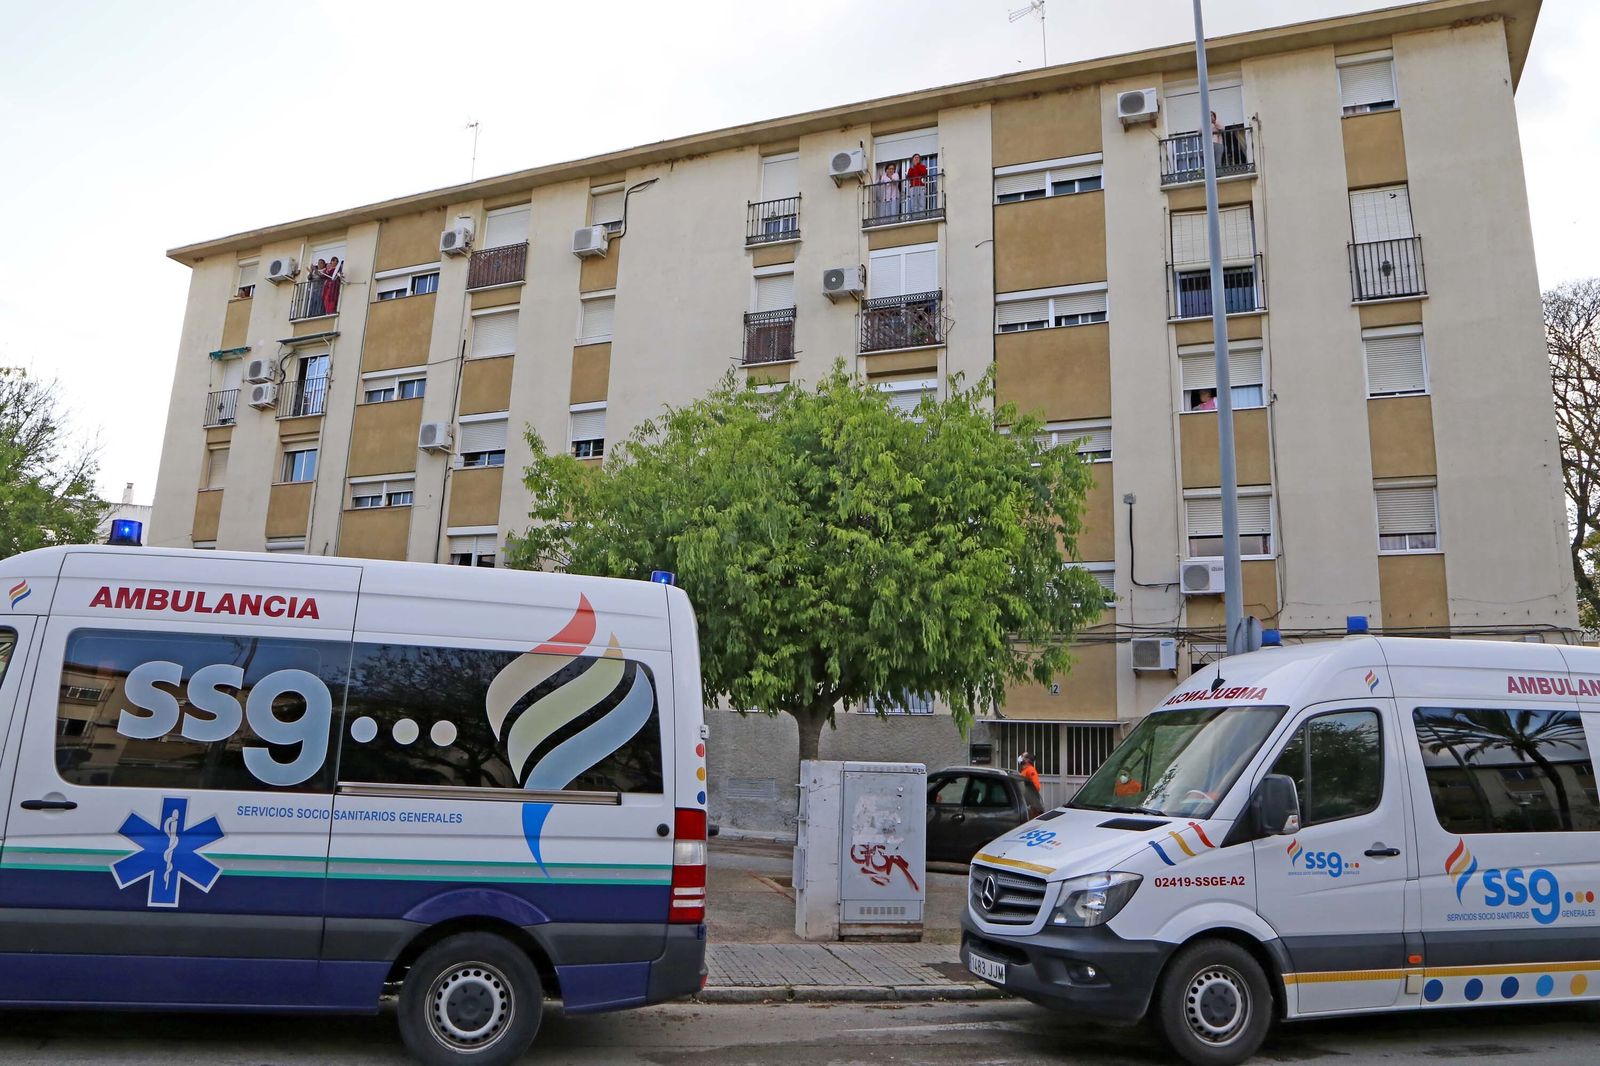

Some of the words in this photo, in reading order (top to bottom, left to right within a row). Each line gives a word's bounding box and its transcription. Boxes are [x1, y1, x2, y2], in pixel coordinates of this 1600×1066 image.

[89, 586, 320, 620] AMBULANCIA
[236, 805, 294, 818] SERVICIOS
[296, 808, 331, 820] SOCIO
[333, 809, 397, 822] SANITARIOS
[399, 811, 463, 824] GENERALES
[1305, 851, 1343, 878] ssg
[1154, 875, 1245, 888] 02419-SSGE-A2
[1482, 868, 1561, 925] ssg
[1447, 912, 1478, 922] SERVICIOS
[1477, 912, 1497, 921] SOCIO
[1497, 911, 1530, 920] SANITARIOS
[1561, 909, 1596, 918] GENERALES
